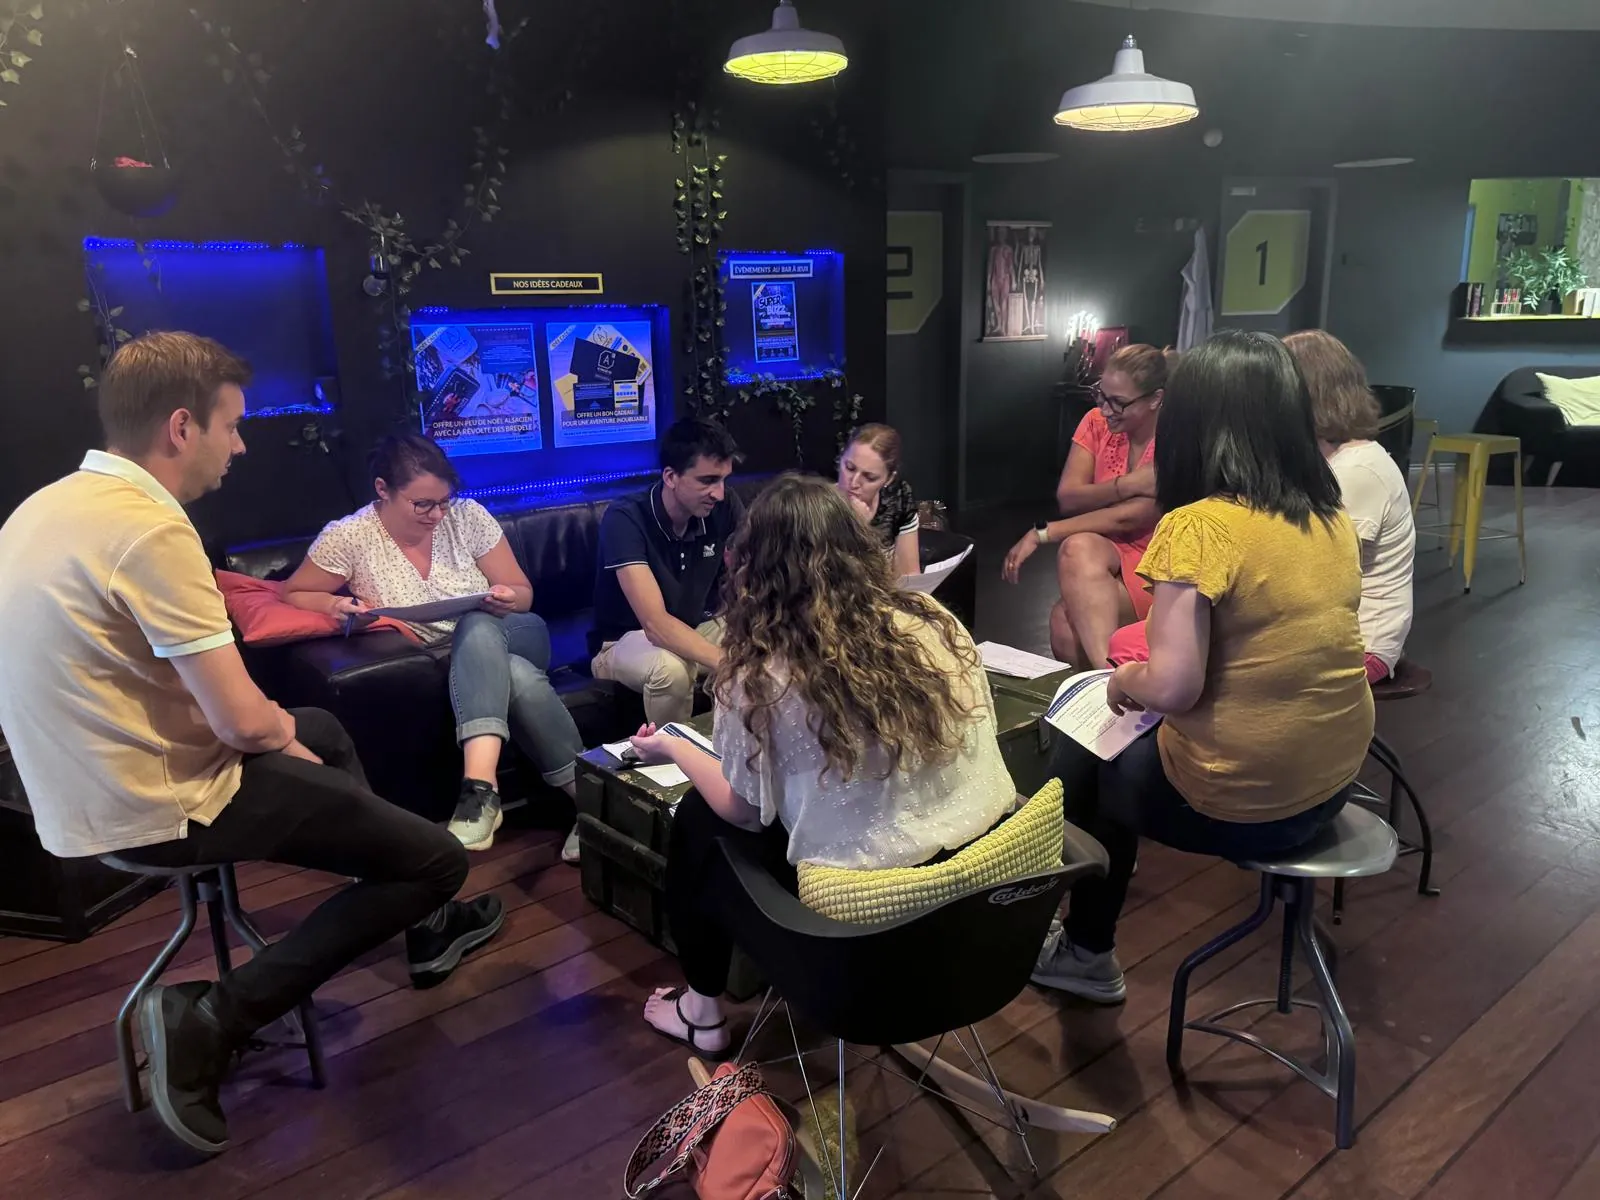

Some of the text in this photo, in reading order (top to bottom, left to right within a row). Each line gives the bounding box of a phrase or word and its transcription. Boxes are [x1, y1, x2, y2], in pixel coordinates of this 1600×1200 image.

[1256, 240, 1268, 286] 1
[513, 279, 583, 288] NOS IDÉES CADEAUX
[576, 411, 593, 419] OFFRE
[589, 417, 616, 425] AVENTURE
[616, 415, 648, 424] INOUBLIABLE
[432, 420, 454, 429] OFFRE
[454, 420, 464, 428] UN
[464, 419, 478, 427] PEU
[504, 415, 533, 424] ALSACIEN
[433, 428, 452, 437] AVEC
[452, 428, 462, 436] LA
[492, 425, 505, 433] DES
